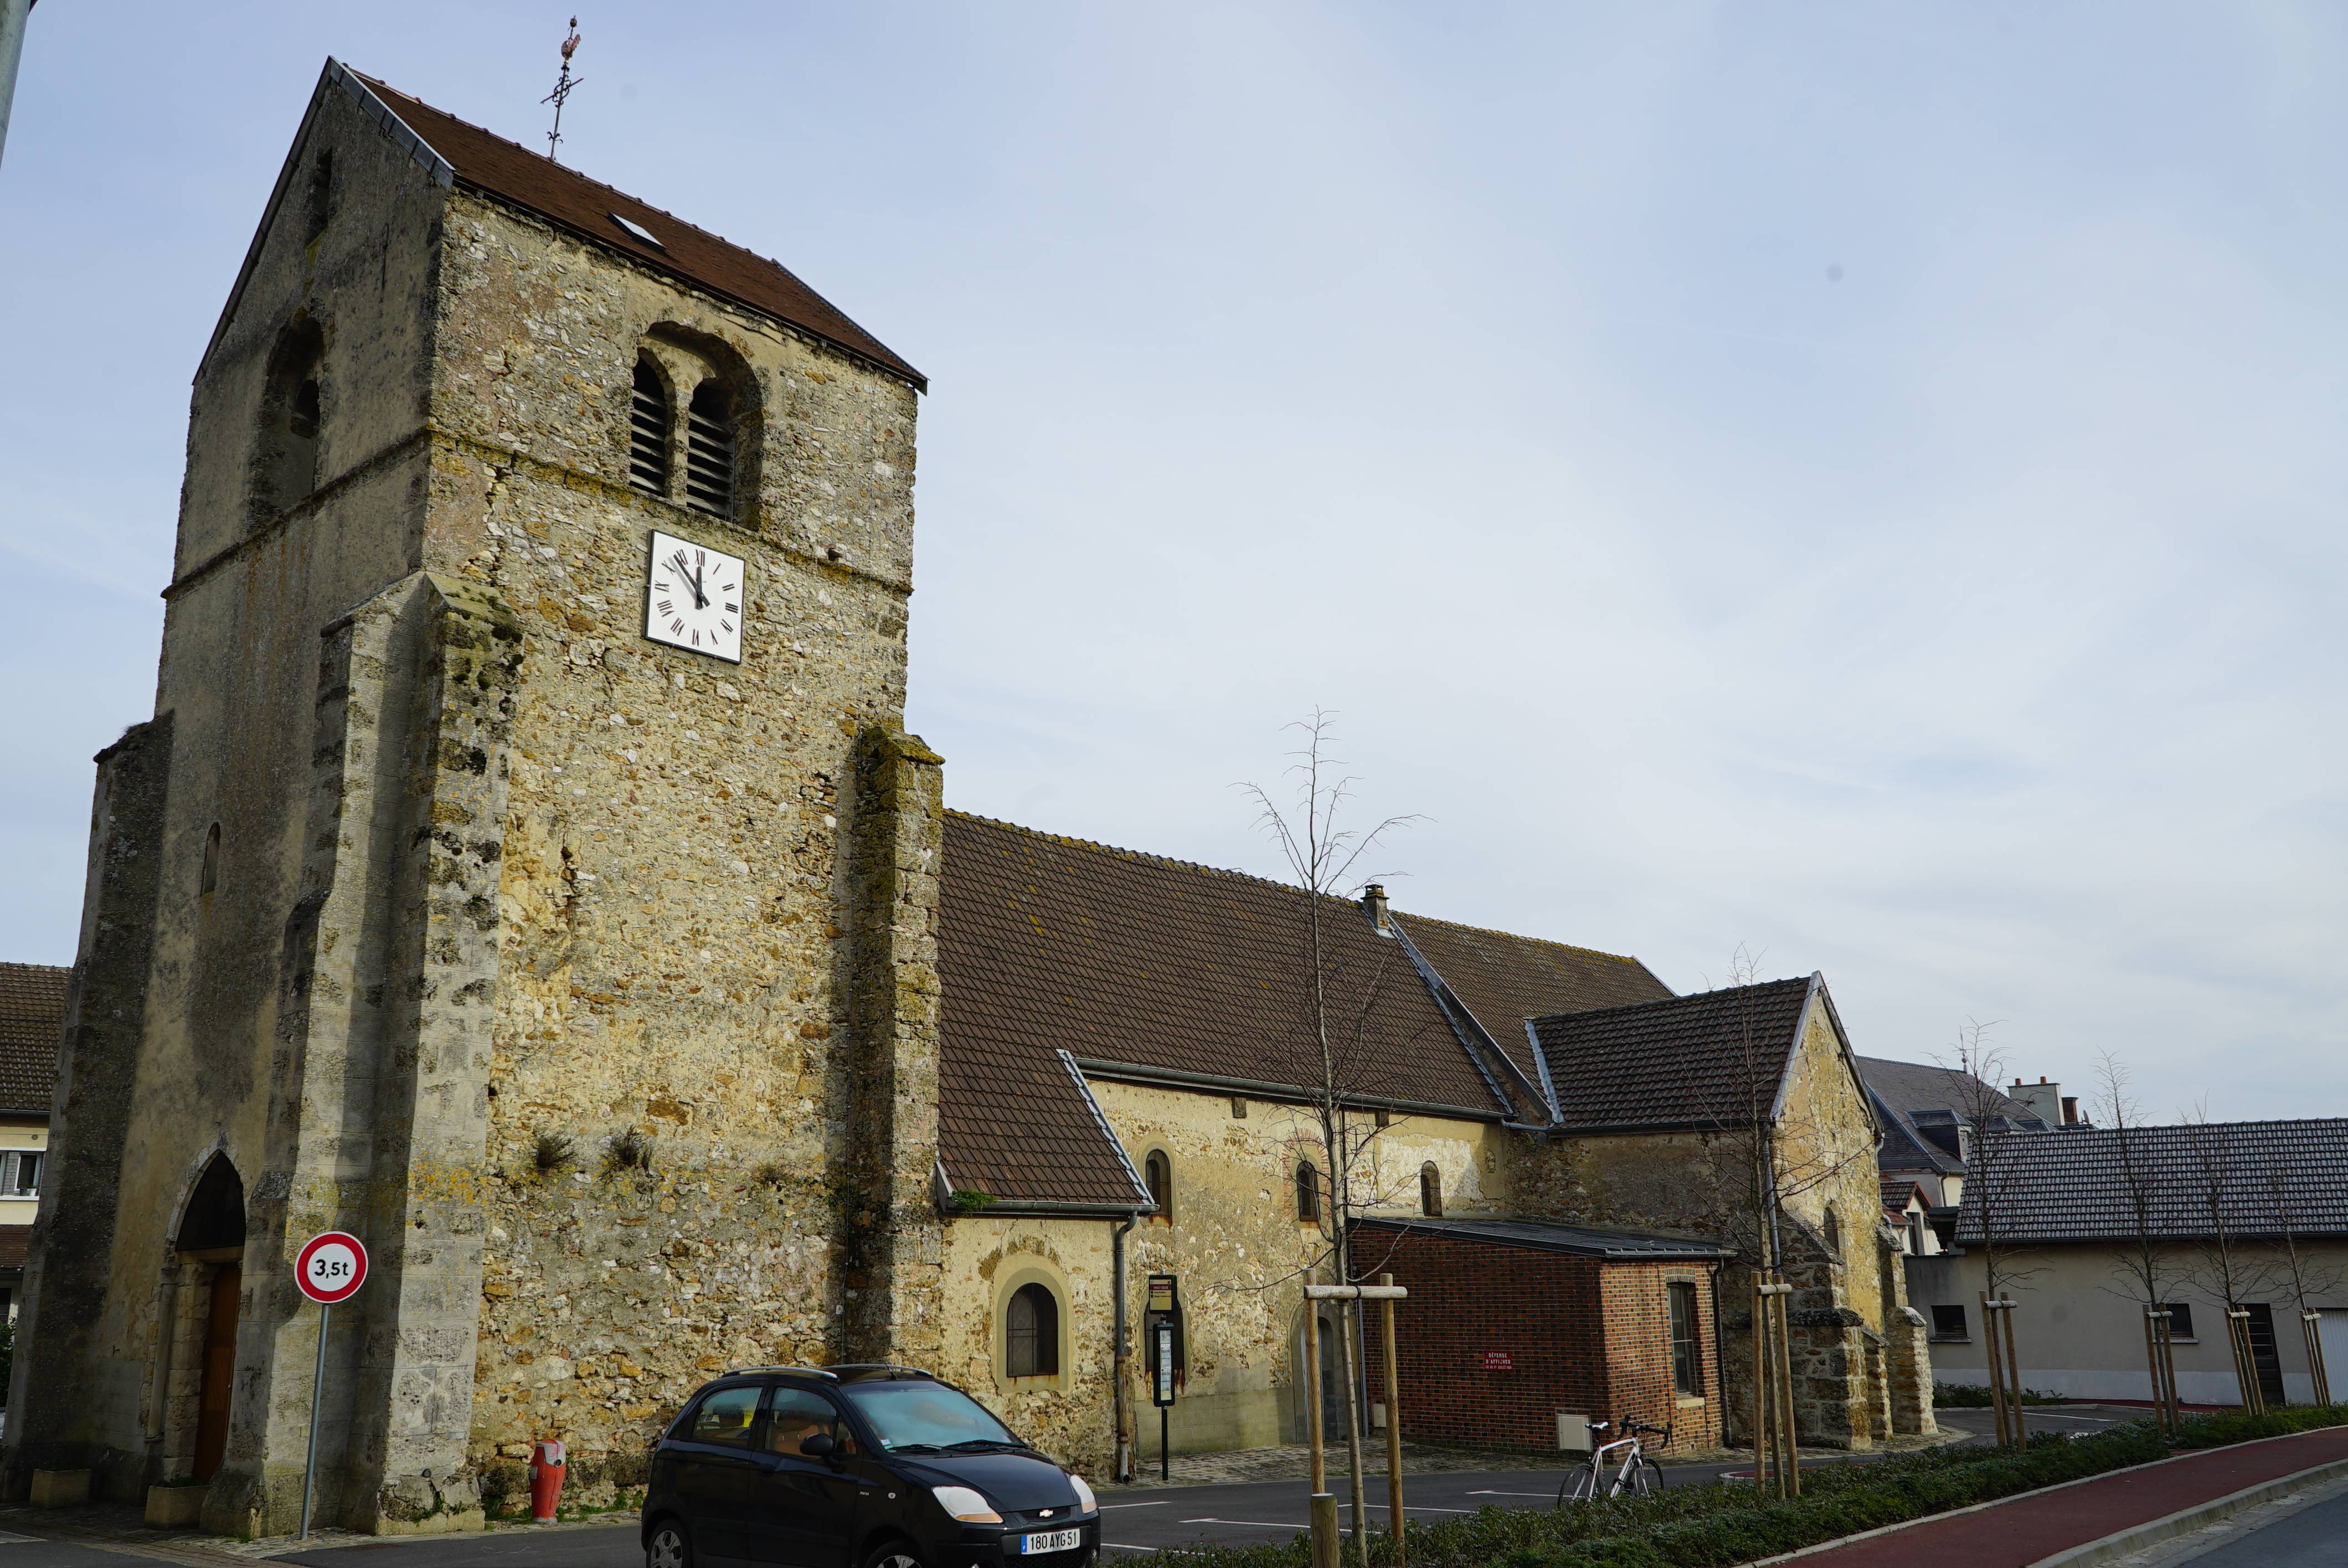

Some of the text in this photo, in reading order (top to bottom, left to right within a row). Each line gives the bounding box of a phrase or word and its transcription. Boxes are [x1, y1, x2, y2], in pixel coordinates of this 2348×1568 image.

[695, 549, 706, 567] XII
[661, 560, 676, 575] X
[713, 563, 721, 575] I
[655, 580, 670, 592] IX
[722, 583, 735, 591] II
[657, 600, 674, 617] VIII
[725, 602, 739, 613] III
[670, 617, 685, 637] VII
[710, 629, 718, 645] V
[1031, 1531, 1077, 1550] 180 AYG 51
